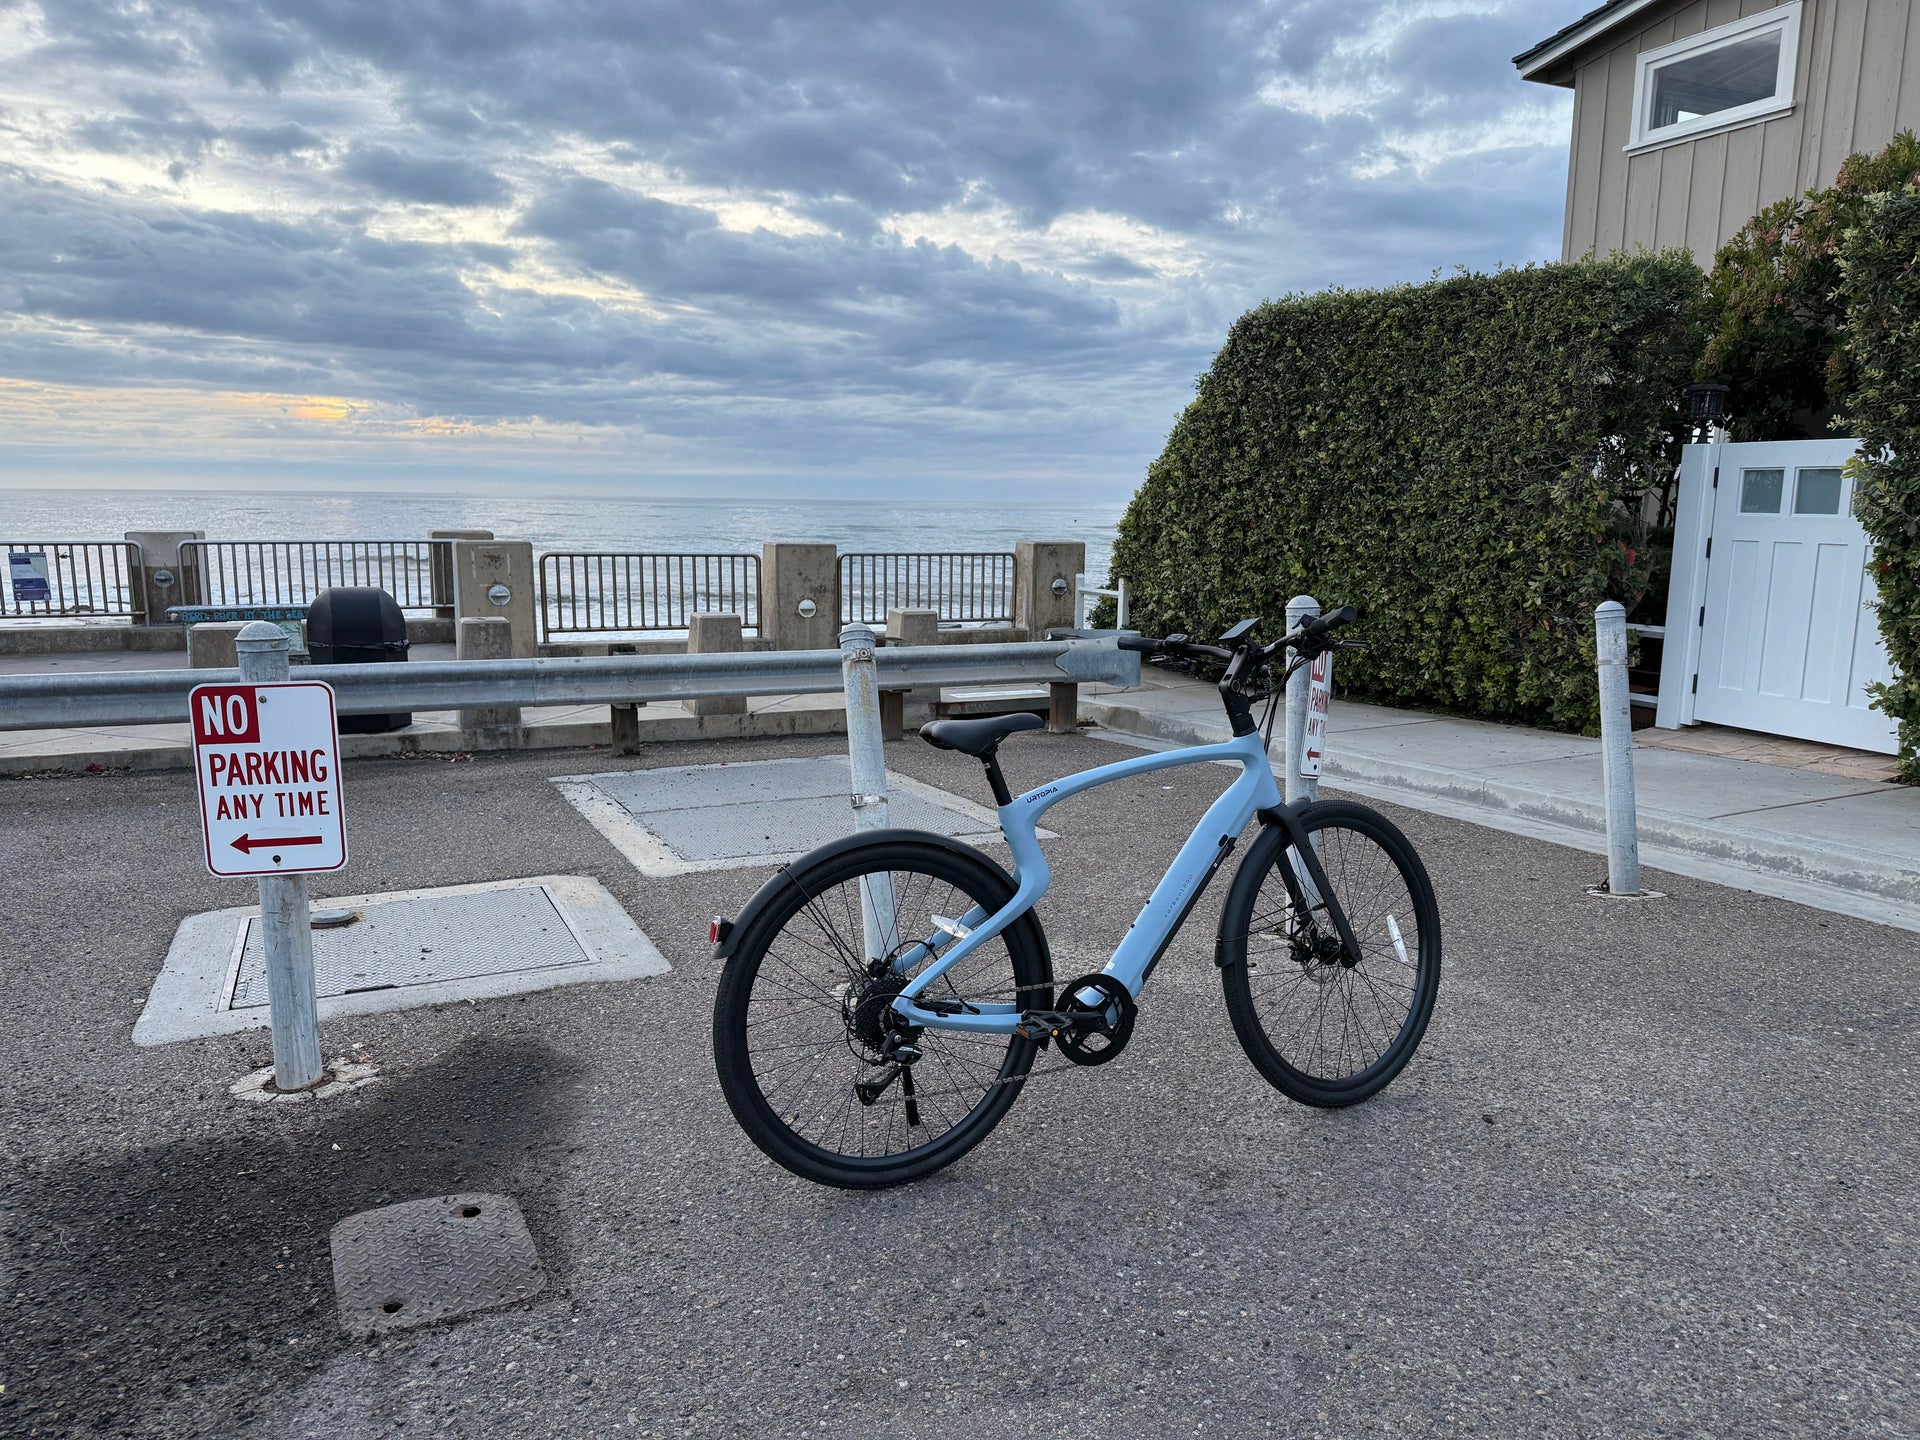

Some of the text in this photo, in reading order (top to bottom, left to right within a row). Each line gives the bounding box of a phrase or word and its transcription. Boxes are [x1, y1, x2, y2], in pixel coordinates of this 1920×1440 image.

[213, 611, 238, 621] ROCK
[244, 610, 256, 620] BY
[262, 609, 281, 620] THE
[286, 609, 304, 619] SEA
[201, 694, 249, 736] NO
[208, 749, 328, 787] PARKING
[216, 790, 330, 820] ANY TIME
[1026, 786, 1058, 803] URTOPIA
